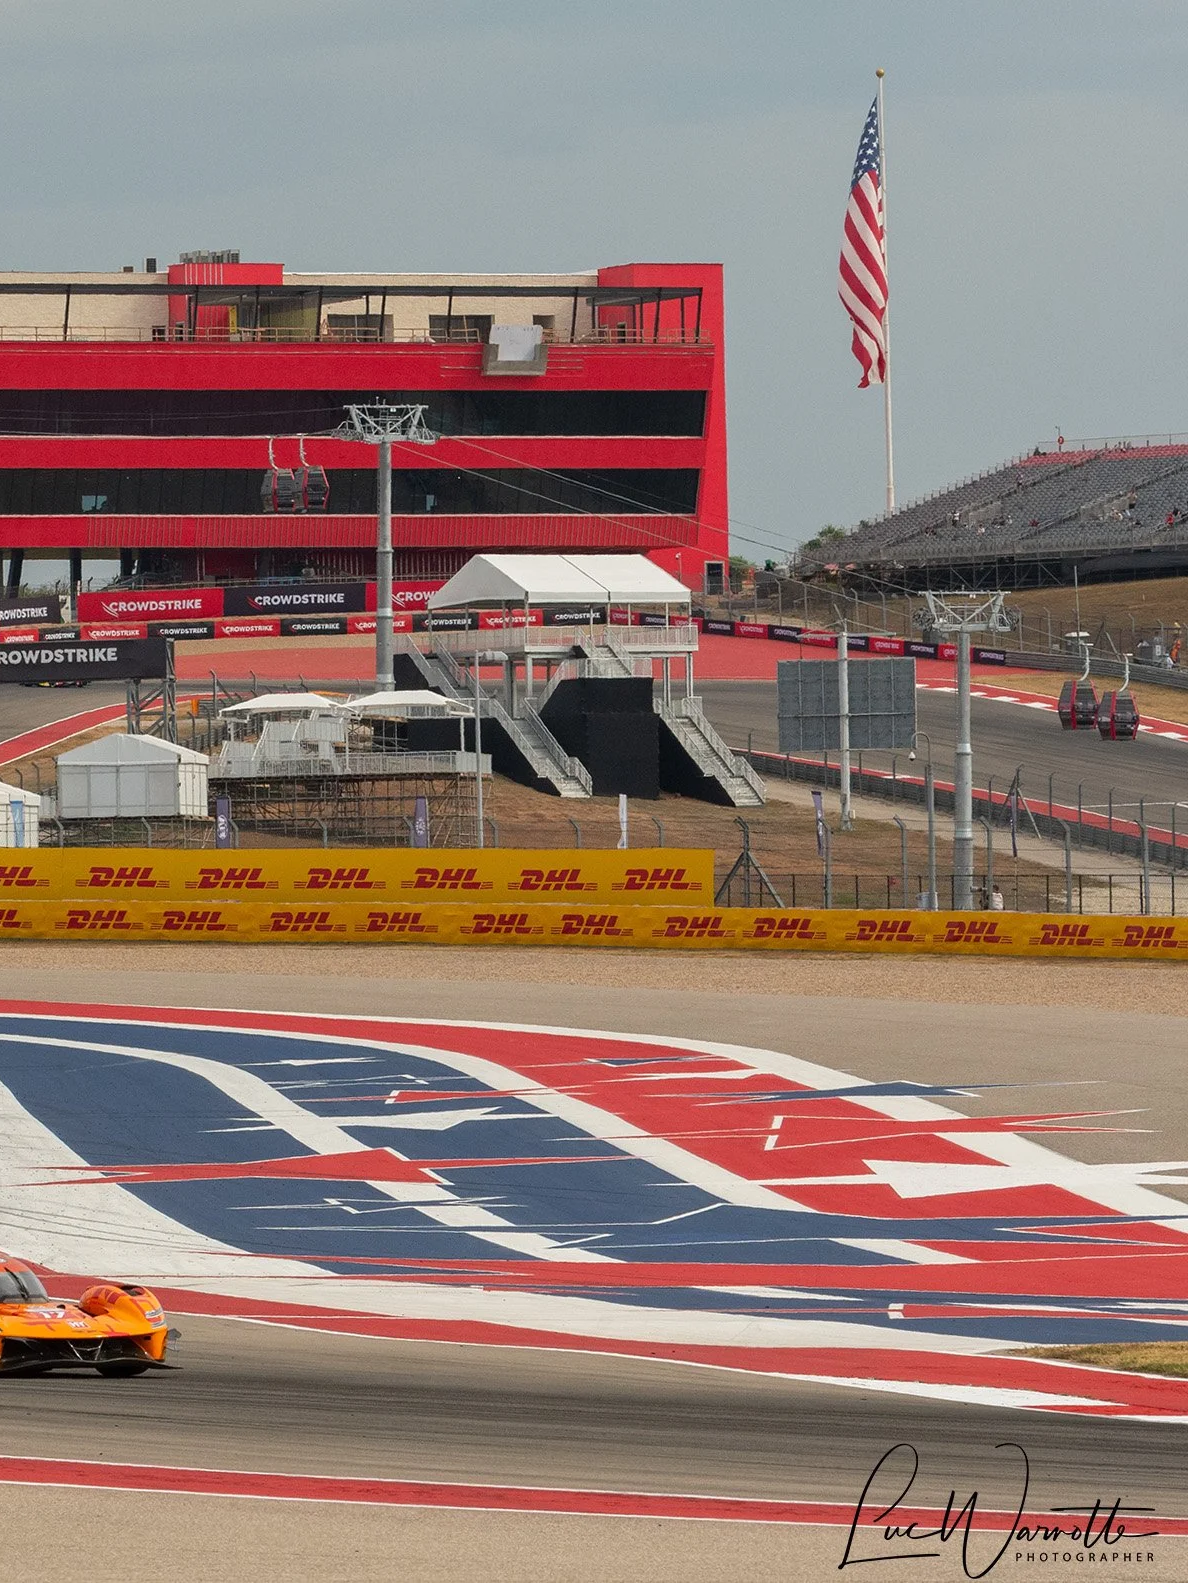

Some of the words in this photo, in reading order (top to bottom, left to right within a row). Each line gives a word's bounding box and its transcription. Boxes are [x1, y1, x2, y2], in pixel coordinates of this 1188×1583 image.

[254, 593, 344, 606] CROWDSTRIKE
[108, 598, 202, 612] CROWDSTRIKE
[160, 627, 208, 635] CROWDSTRIKE
[225, 624, 273, 633] CROWDSTRIKE
[292, 622, 340, 631] CROWDSTRIKE
[92, 629, 140, 638] CROWDSTRIKE
[87, 867, 158, 888] DHL
[197, 868, 268, 889] DHL
[306, 868, 372, 889] DHL
[413, 868, 482, 890] DHL
[518, 869, 586, 891] DHL
[623, 869, 691, 891] DHL
[65, 910, 132, 930] DHL
[161, 911, 227, 932] DHL
[270, 911, 335, 932] DHL
[365, 912, 428, 933] DHL
[472, 914, 533, 935] DHL
[560, 914, 622, 936] DHL
[663, 916, 726, 938] DHL
[753, 917, 815, 939] DHL
[856, 920, 915, 942] DHL
[944, 921, 1002, 944] DHL
[1039, 924, 1093, 946] DHL
[1122, 926, 1179, 948] DHL
[38, 1311, 66, 1319] 17
